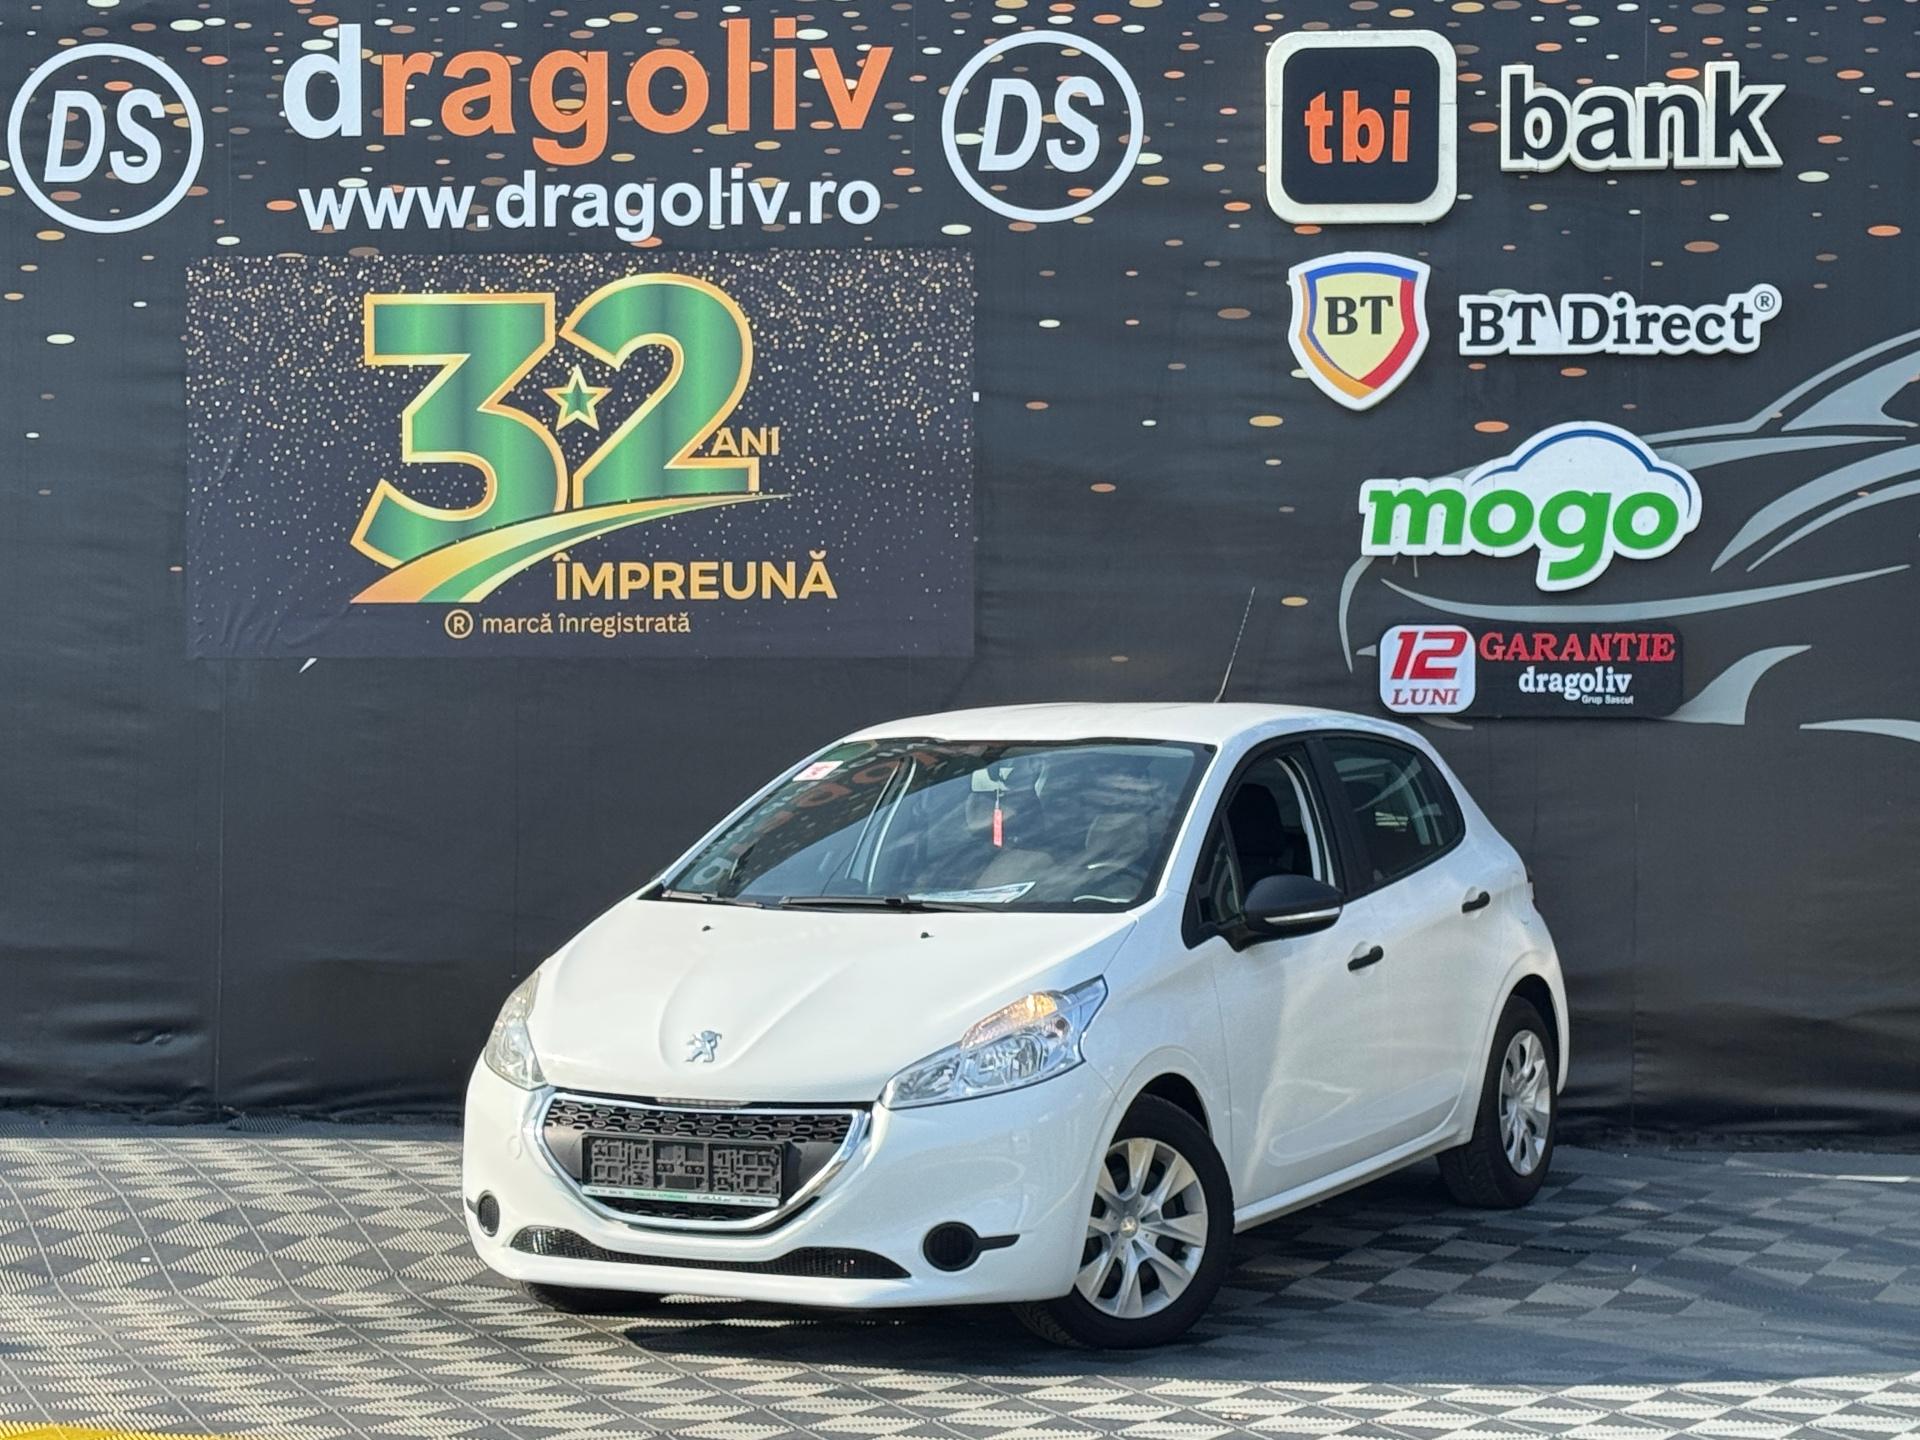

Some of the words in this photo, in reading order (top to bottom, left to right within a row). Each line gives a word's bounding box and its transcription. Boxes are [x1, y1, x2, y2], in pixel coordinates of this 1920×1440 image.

[283, 17, 893, 166] dragoliv
[1303, 89, 1411, 164] tbi
[1507, 68, 1776, 164] bank
[44, 88, 165, 184] DS
[978, 76, 1104, 172] DS
[299, 168, 881, 242] www.dragoliv.ro
[1324, 295, 1394, 335] BT
[1466, 300, 1547, 346] BT
[351, 273, 759, 568] 32
[711, 427, 779, 456] ANI
[1369, 489, 1679, 581] mogo
[552, 550, 838, 600] ÎMPREUNĂ
[482, 613, 553, 634] marcă
[559, 613, 691, 638] înregistrată
[1479, 632, 1676, 662] GARANTIE
[1390, 631, 1467, 680] 12
[1390, 688, 1460, 705] LUNI
[1518, 666, 1632, 700] dragoliv
[1581, 695, 1603, 705] Grup
